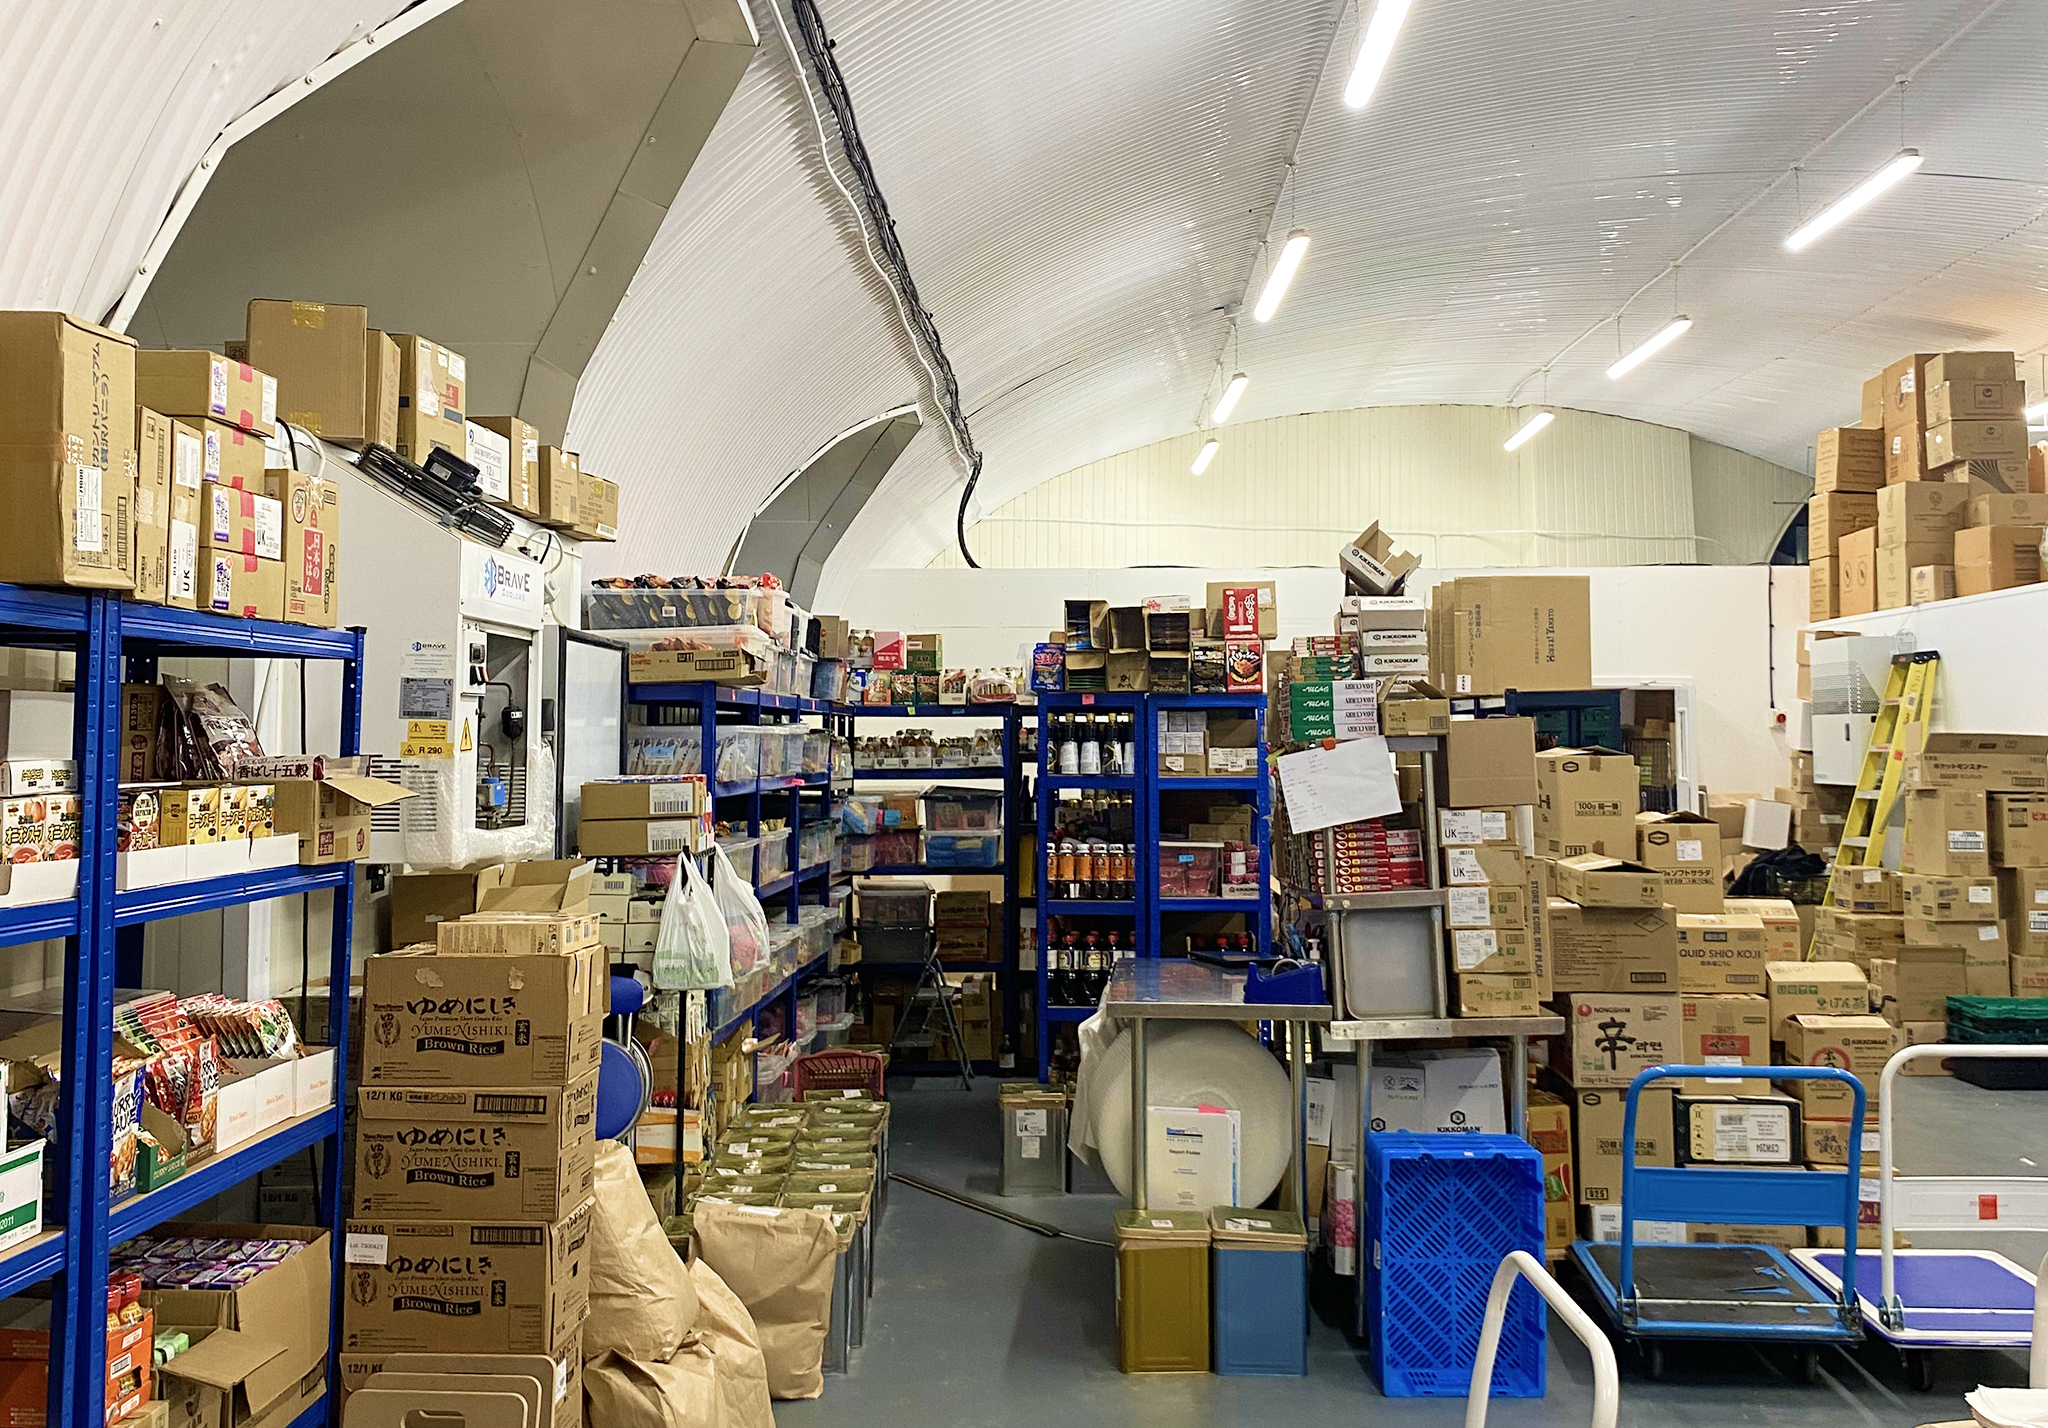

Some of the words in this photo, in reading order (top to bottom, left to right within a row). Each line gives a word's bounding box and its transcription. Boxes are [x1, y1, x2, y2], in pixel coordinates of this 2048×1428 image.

[256, 529, 266, 546] UK
[1358, 554, 1387, 578] KIKKOMAN
[183, 569, 191, 592] UK
[498, 564, 530, 593] BRAVE
[419, 746, 425, 754] R
[427, 746, 443, 754] 290
[237, 763, 309, 779] 香ばし十五穀
[1444, 828, 1457, 839] UK
[1452, 867, 1466, 878] UK
[1671, 869, 1711, 877] ソフトサラダ
[1531, 879, 1540, 905] STORE
[1532, 905, 1540, 914] IN
[1532, 915, 1541, 937] COOL
[1533, 938, 1542, 953] DRY
[1708, 949, 1735, 959] SHIO
[1736, 949, 1761, 959] KOJI
[406, 996, 517, 1016] ゆめにしき
[410, 1022, 451, 1039] YUME
[453, 1022, 509, 1041] NISHIKI
[424, 1038, 465, 1052] Brown
[469, 1042, 497, 1054] Rice
[1595, 1016, 1637, 1071] 辛
[1635, 1040, 1663, 1053] 라면
[114, 1090, 140, 1118] URRY
[365, 1090, 388, 1101] 12/1
[389, 1091, 404, 1101] KG
[113, 1105, 137, 1135] AUCE
[1018, 1124, 1029, 1132] UK
[396, 1126, 507, 1147] ゆめにしき
[401, 1153, 442, 1171] YUME
[442, 1153, 499, 1172] NISHIKI
[414, 1169, 455, 1184] Brown
[458, 1174, 487, 1187] Rice
[347, 1224, 370, 1235] 12/1
[371, 1225, 385, 1235] KG
[384, 1255, 492, 1275] ゆめにしき
[387, 1282, 428, 1298] YUME
[429, 1282, 486, 1300] NISHIKI
[401, 1297, 442, 1314] Brown
[445, 1302, 474, 1315] Rice
[347, 1363, 369, 1373] 12/1
